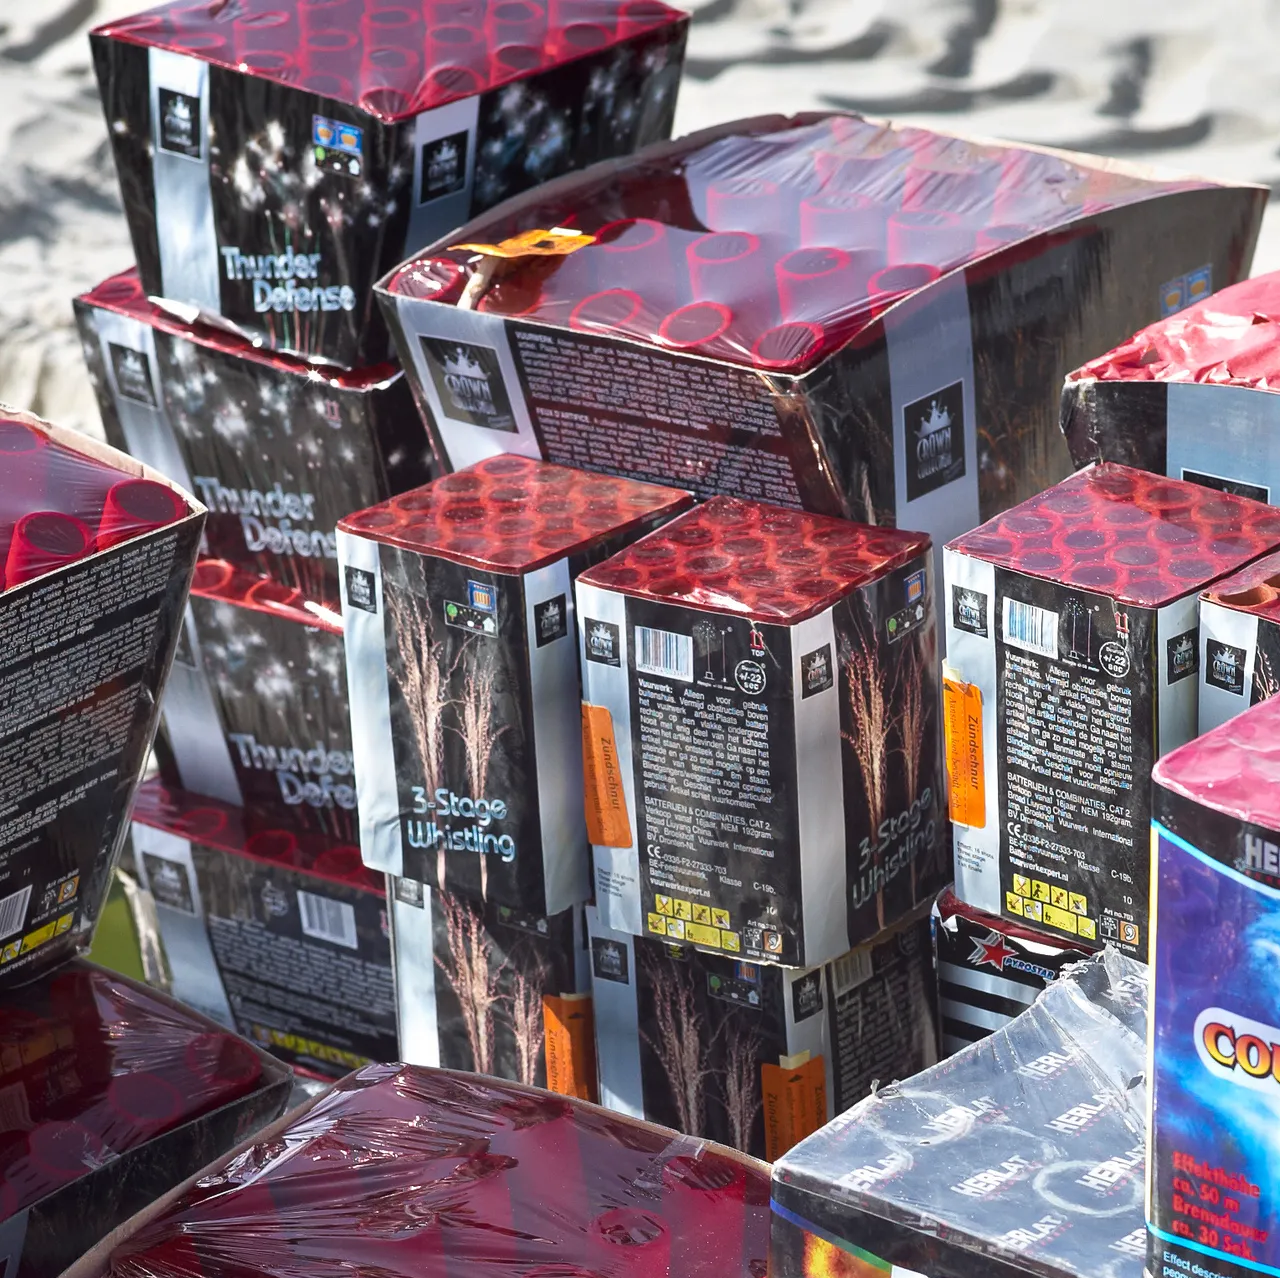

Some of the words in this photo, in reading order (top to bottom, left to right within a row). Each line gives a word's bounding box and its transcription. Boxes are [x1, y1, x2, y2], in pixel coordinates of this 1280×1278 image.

[221, 245, 321, 280] Thunder
[253, 279, 356, 313] Defense
[194, 476, 315, 521] Thunder
[739, 672, 762, 683] +/-22
[744, 682, 759, 690] sec
[601, 737, 620, 810] Zündschnur
[968, 715, 979, 790] Zündschnur
[411, 785, 508, 827] 3-Stage
[407, 819, 516, 863] Whistling
[858, 787, 931, 871] 3-Stage
[852, 819, 936, 909] Whistling
[1004, 957, 1055, 980] PYROSTAR
[950, 1154, 1030, 1197] HERLAT
[1200, 1185, 1220, 1205] 50
[1224, 1196, 1241, 1213] m
[1200, 1225, 1219, 1246] 30
